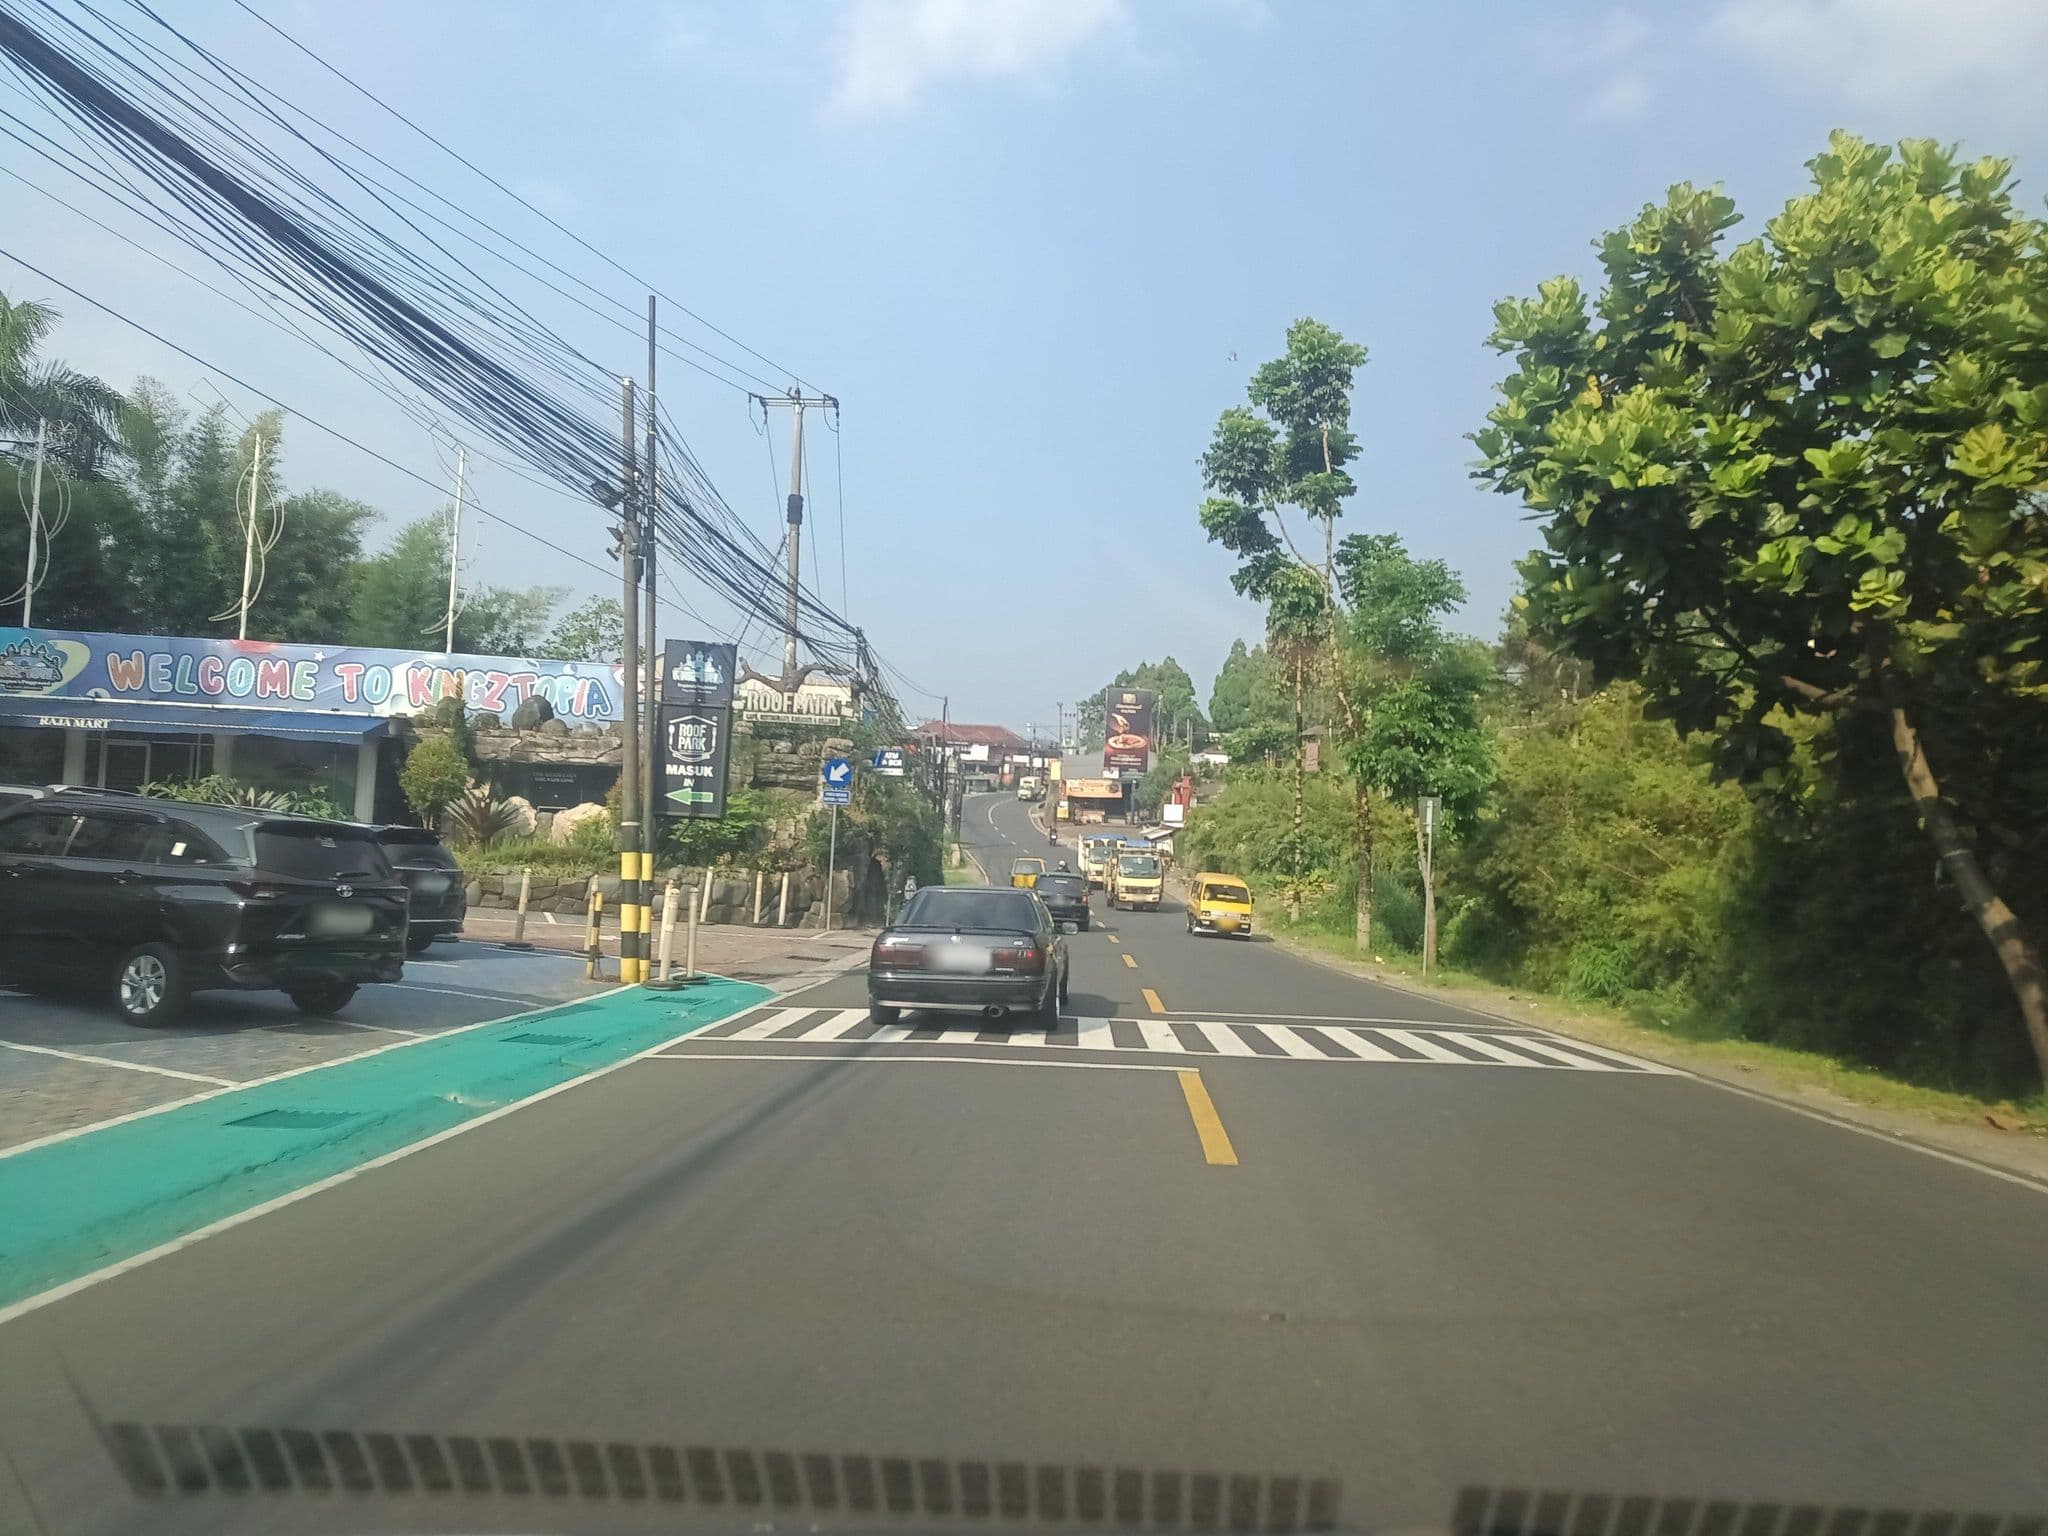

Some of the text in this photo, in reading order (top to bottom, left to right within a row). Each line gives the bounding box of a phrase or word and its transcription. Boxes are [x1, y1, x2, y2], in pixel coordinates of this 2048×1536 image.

[106, 650, 612, 718] WELCOME TO KINGZTOPIA
[40, 716, 110, 729] RAJA MART
[679, 723, 707, 737] ROOF
[677, 736, 706, 751] PARK
[665, 764, 713, 778] MASUK
[683, 778, 695, 787] IN
